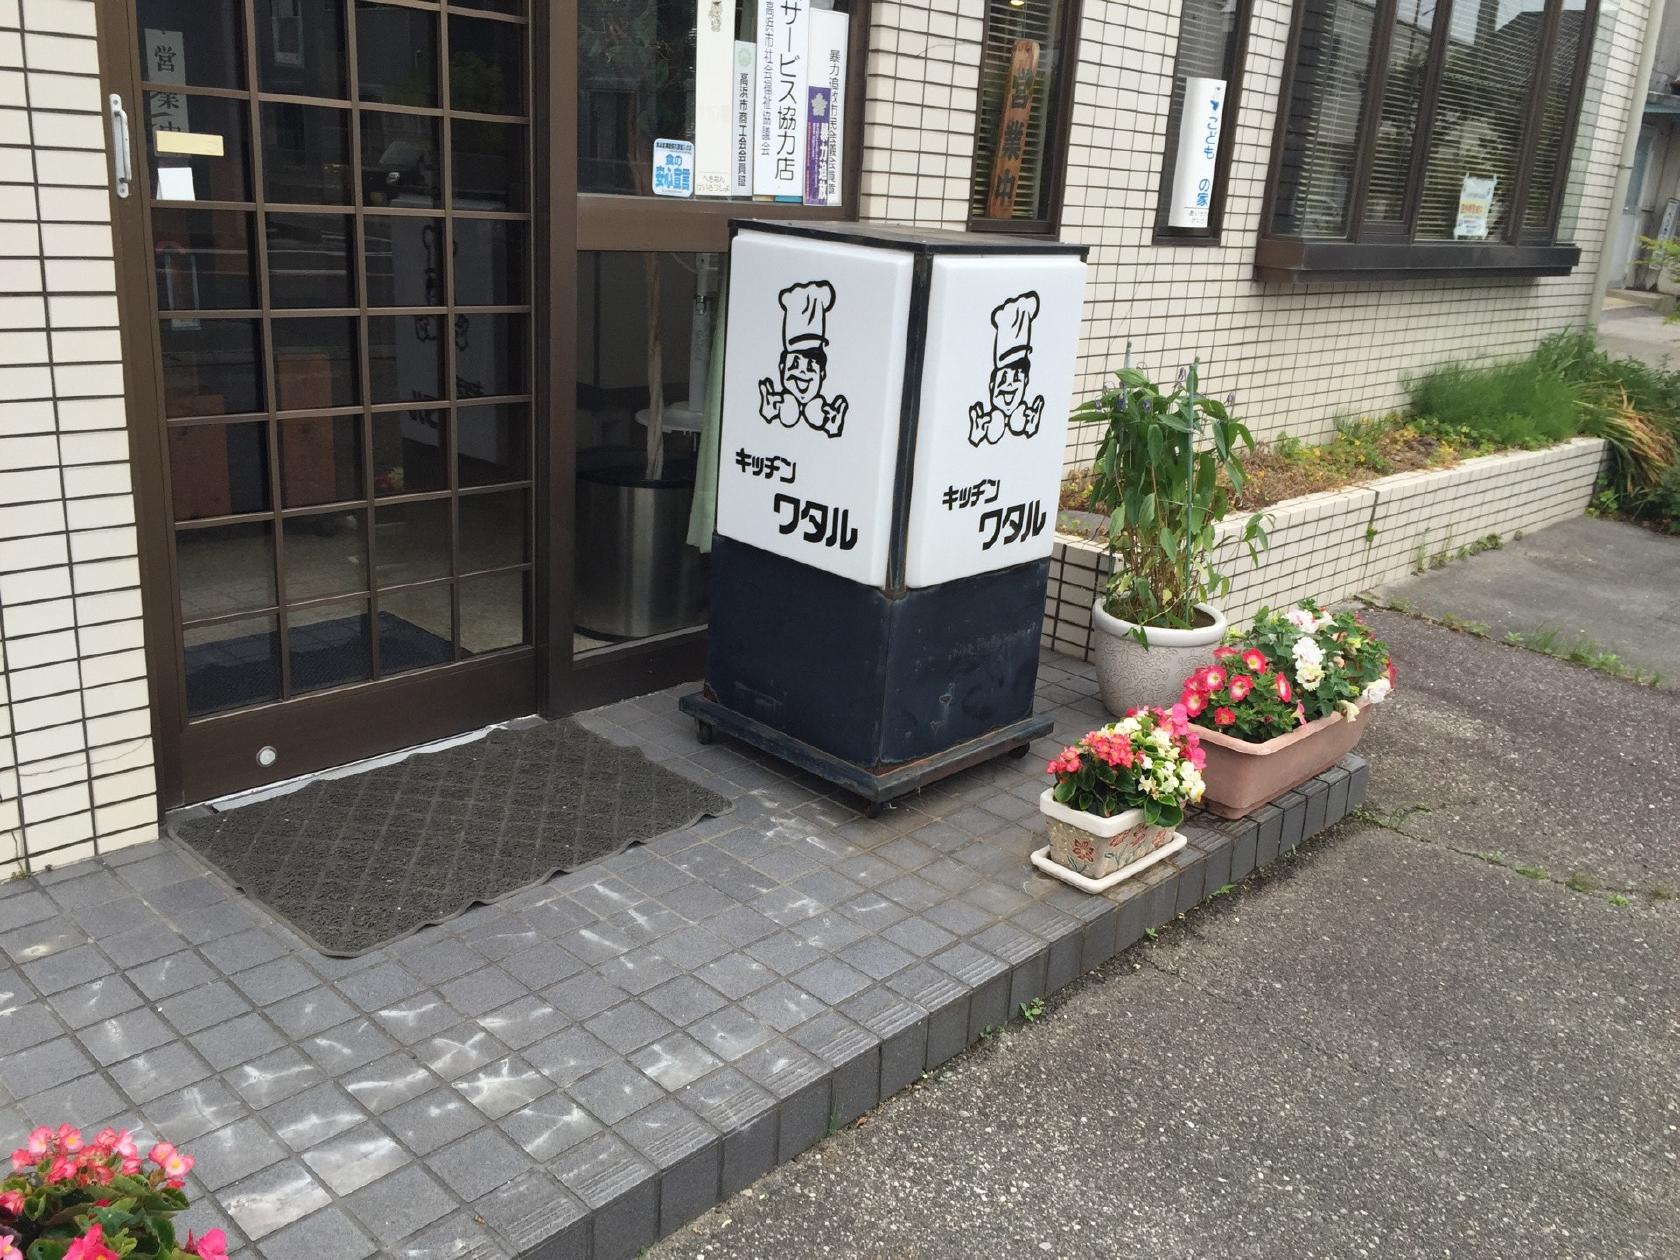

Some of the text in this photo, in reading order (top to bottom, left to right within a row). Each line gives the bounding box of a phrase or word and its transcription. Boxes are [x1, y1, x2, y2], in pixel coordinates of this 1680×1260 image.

[775, 0, 801, 181] サービス協力店
[995, 67, 1032, 206] 営業中
[735, 448, 796, 483] キッチン
[773, 493, 858, 550] ワタル
[942, 479, 1000, 511] キッチン
[979, 499, 1047, 551] ワタル
